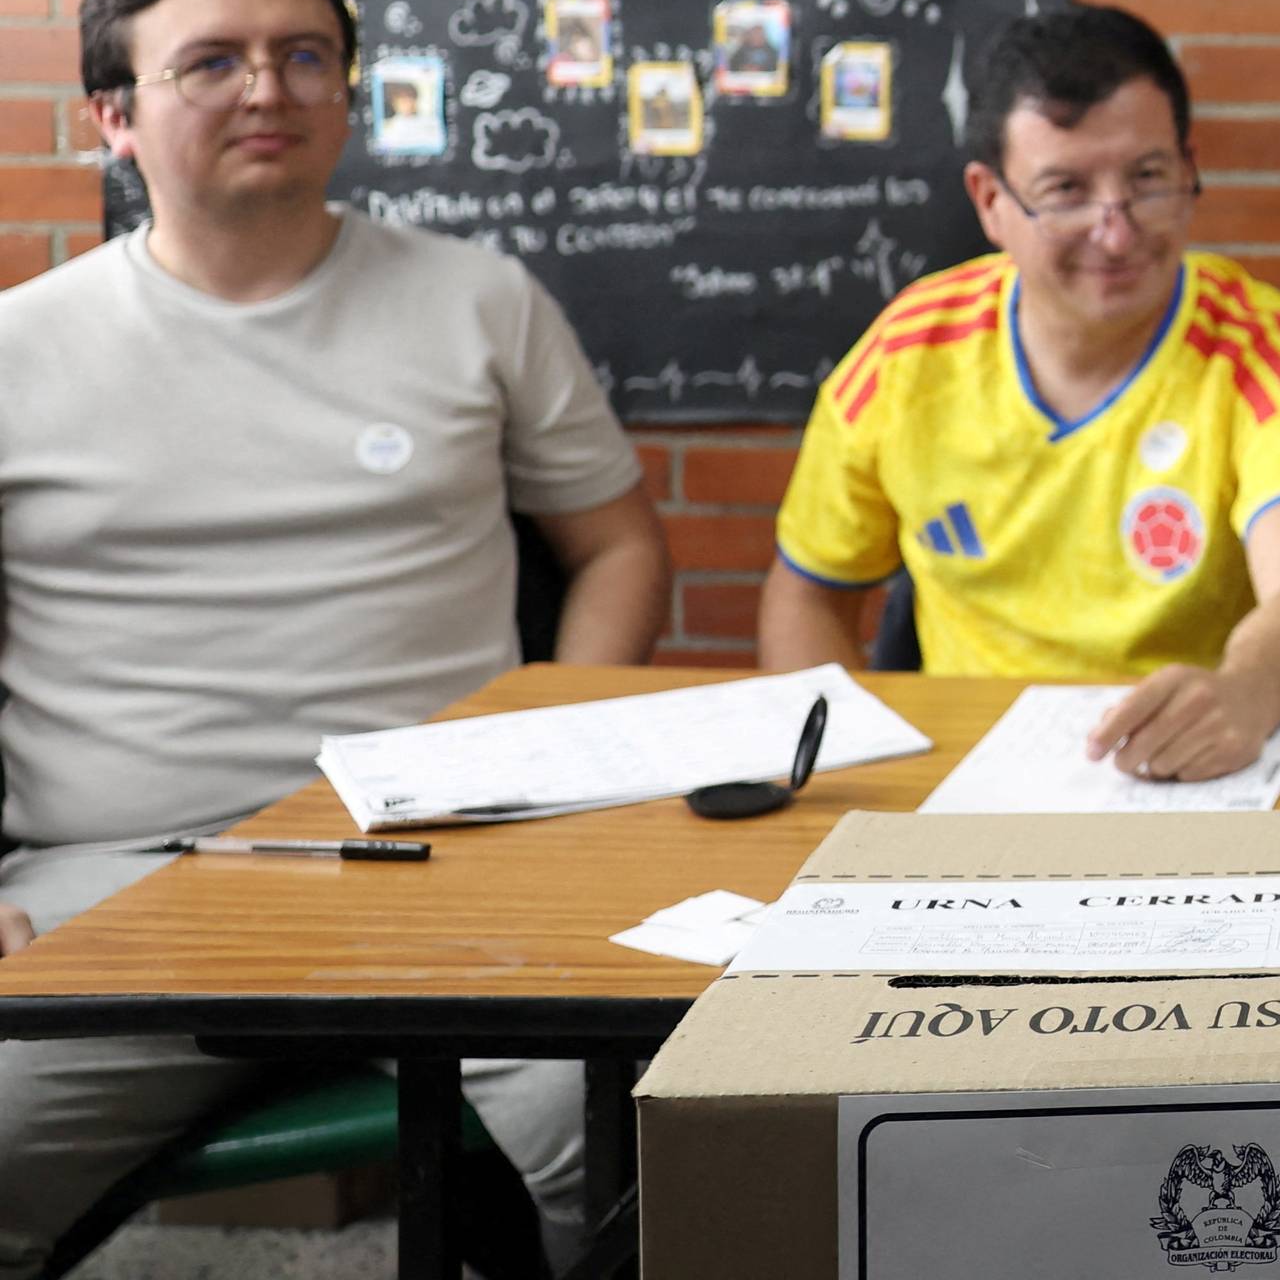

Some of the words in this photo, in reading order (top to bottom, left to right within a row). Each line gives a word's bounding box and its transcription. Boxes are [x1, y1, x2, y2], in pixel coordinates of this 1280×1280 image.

[891, 897, 1025, 911] URNA
[850, 1002, 1018, 1044] AQUÍ
[1029, 1003, 1192, 1035] VOTO
[1203, 1235, 1243, 1245] COLOMBIA
[1171, 1247, 1228, 1263] ORGANIZACIÓN
[1230, 1250, 1274, 1261] ELECTORAL
